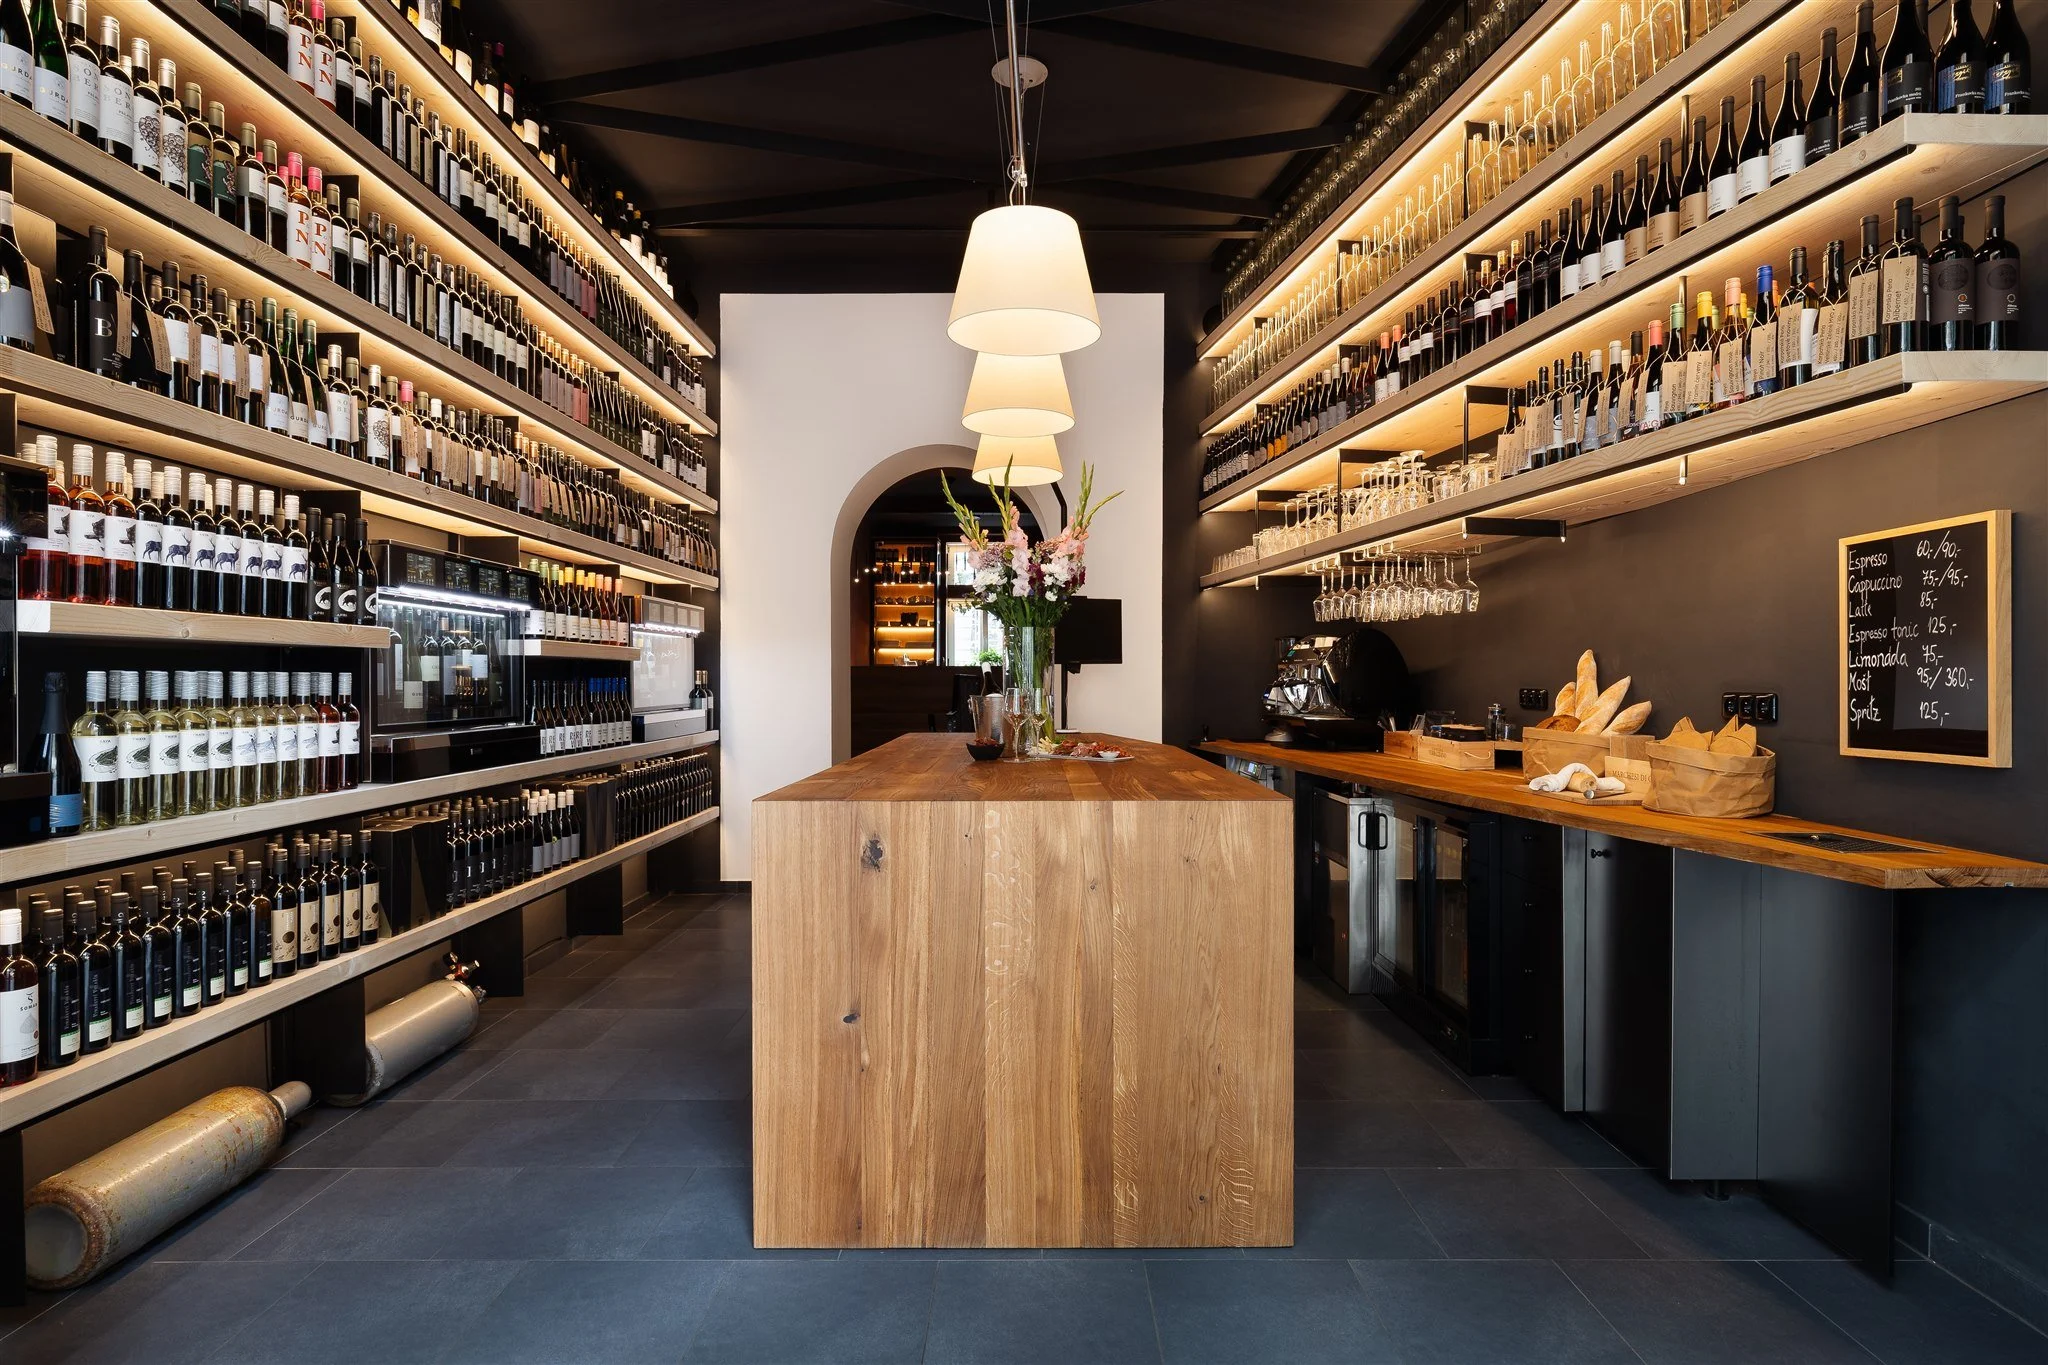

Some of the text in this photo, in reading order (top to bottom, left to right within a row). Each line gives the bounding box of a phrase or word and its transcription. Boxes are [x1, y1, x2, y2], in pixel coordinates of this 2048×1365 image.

[1848, 550, 1888, 575] Espresso
[1848, 574, 1902, 604] Cappuccino
[1849, 590, 1938, 618] Latte 85,-
[1849, 624, 1888, 654] Espresso
[1891, 617, 1919, 641] tonic
[1848, 642, 1943, 668] Limonáda 75,-
[1850, 695, 1881, 730] Spritz
